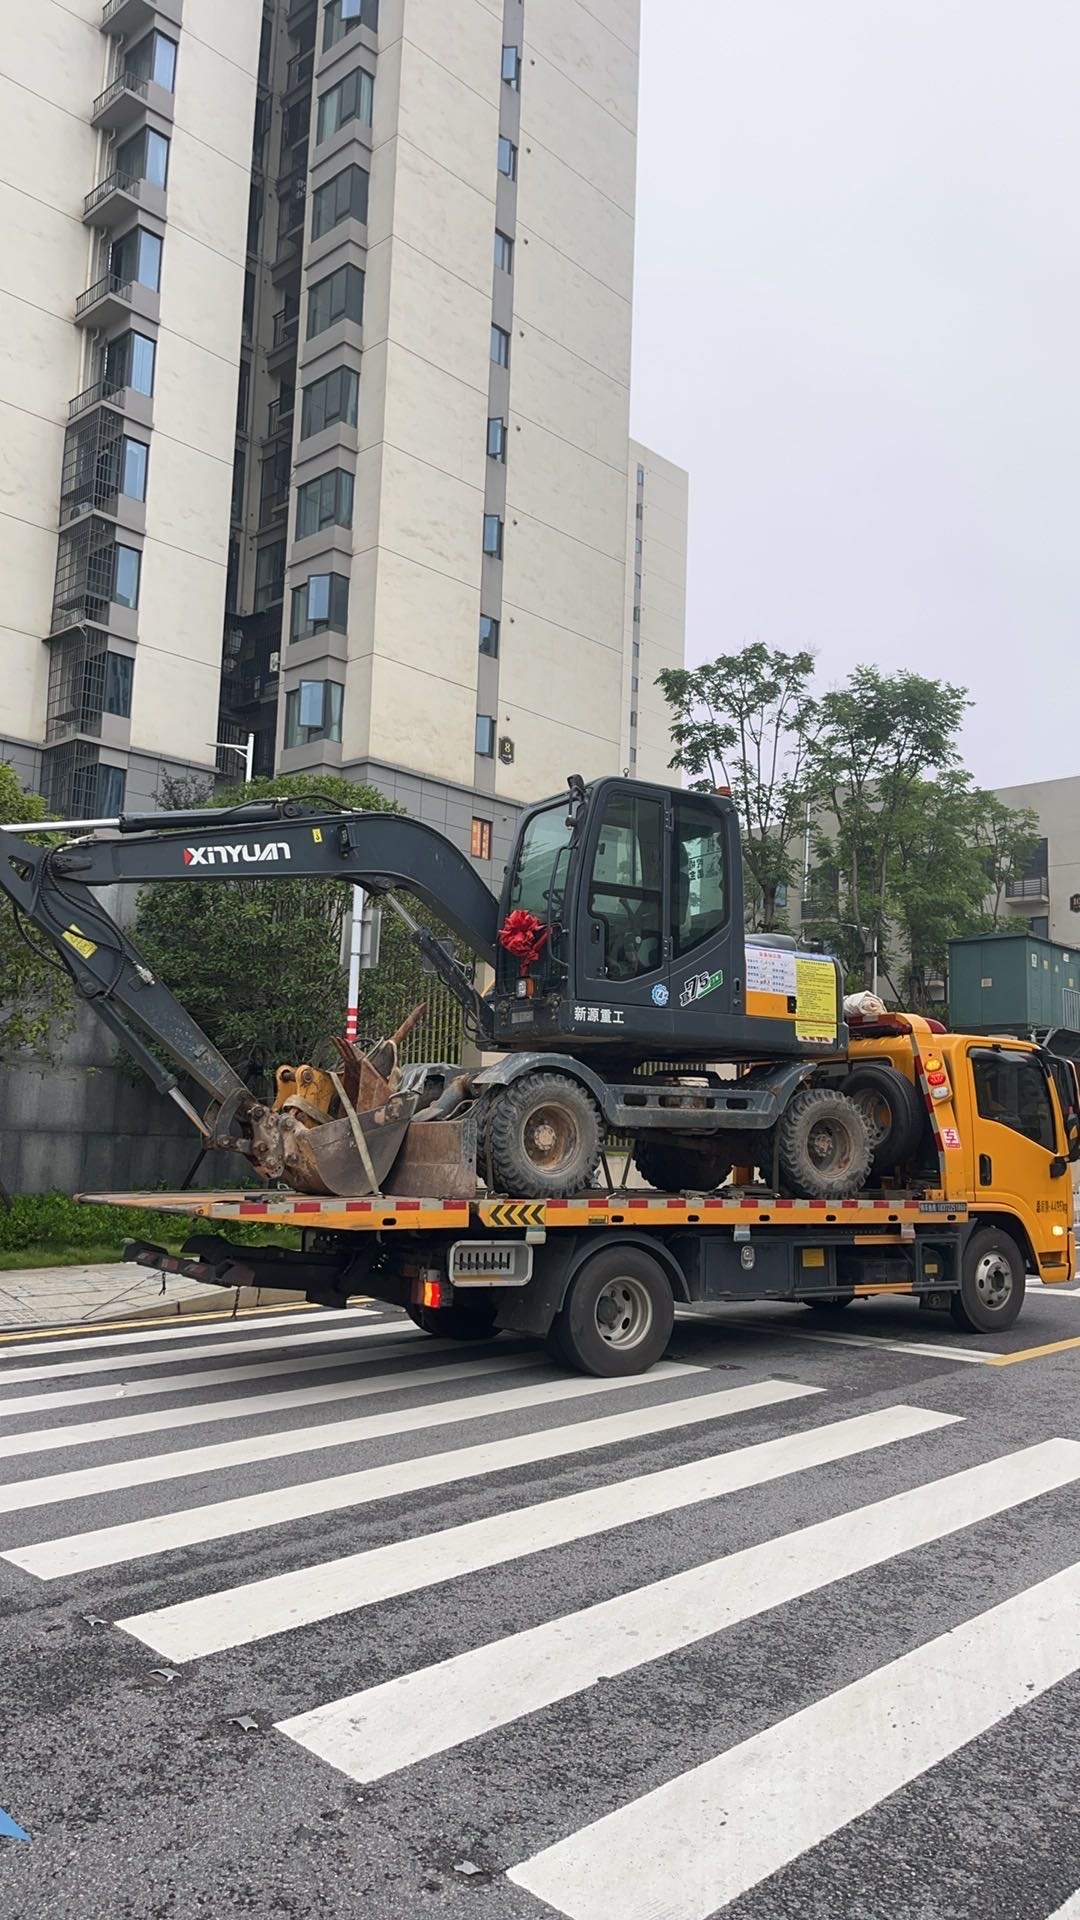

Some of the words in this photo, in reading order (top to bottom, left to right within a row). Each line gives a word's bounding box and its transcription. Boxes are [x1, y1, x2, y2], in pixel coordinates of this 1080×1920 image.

[504, 742, 511, 753] 8
[187, 842, 291, 866] XINYUAN
[574, 1006, 625, 1024] 新源重工
